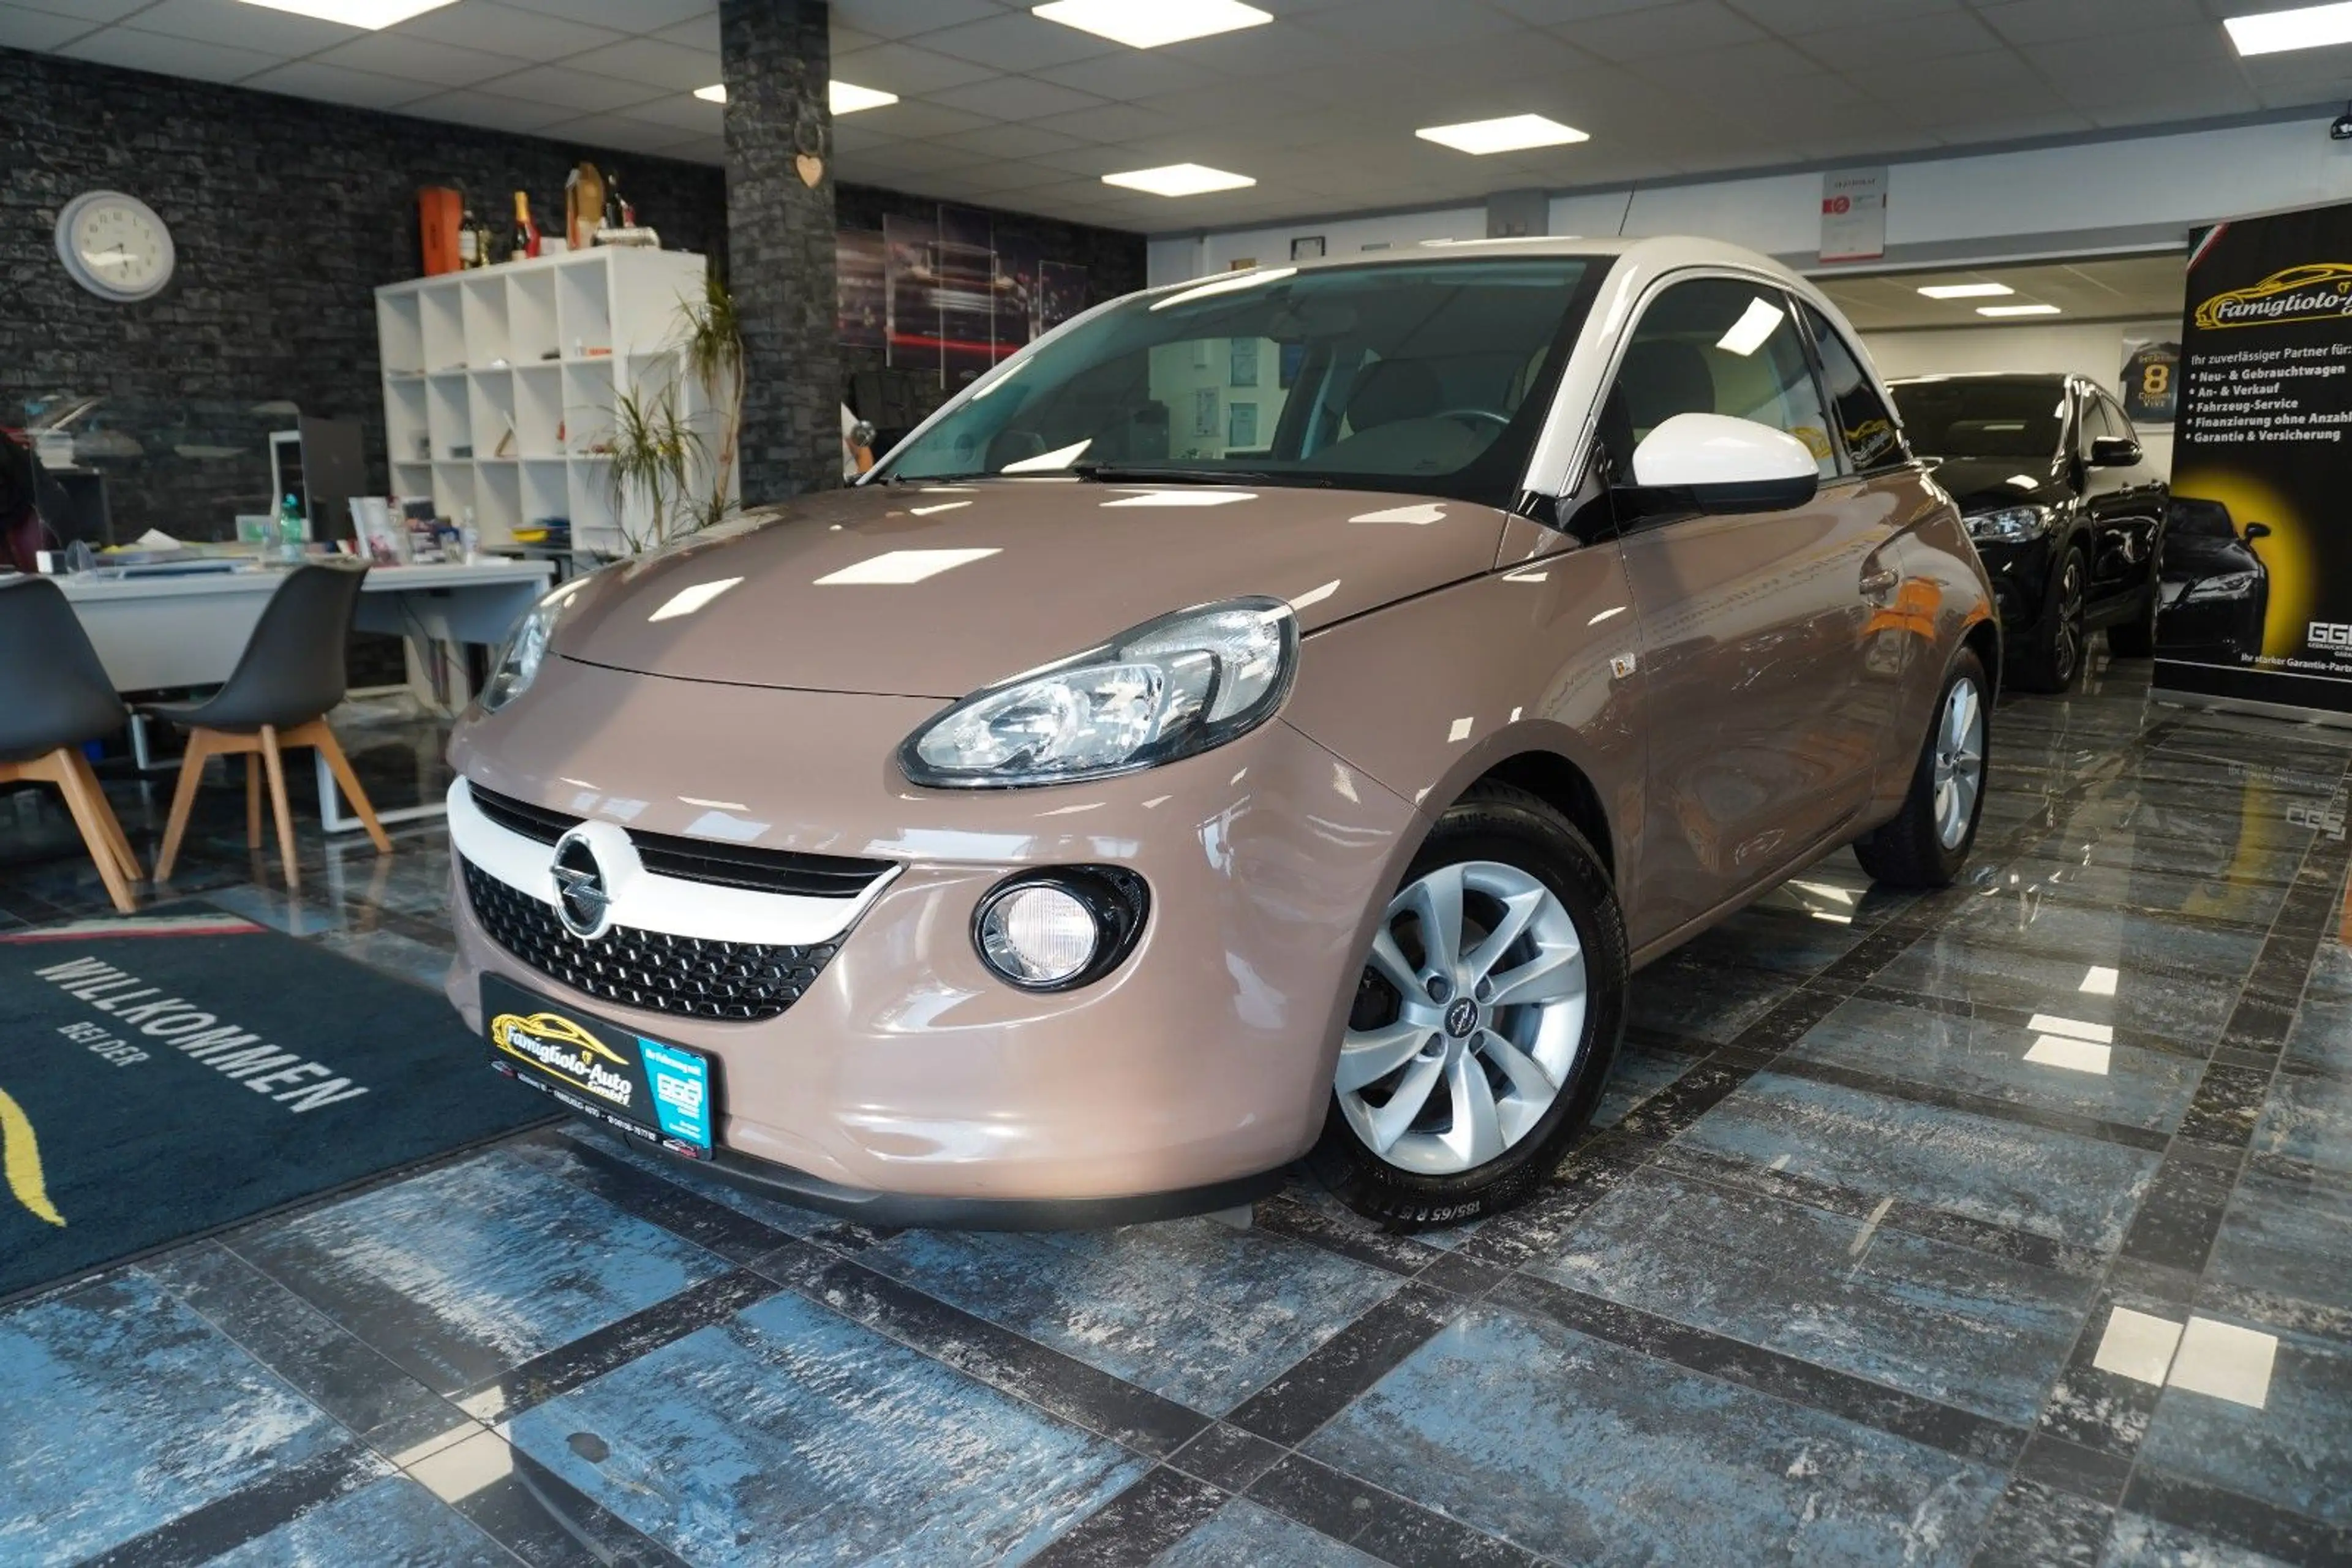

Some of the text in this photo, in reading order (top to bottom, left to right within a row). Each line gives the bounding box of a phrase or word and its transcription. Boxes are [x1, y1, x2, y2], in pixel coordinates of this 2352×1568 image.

[2192, 355, 2206, 366] Ihr
[2208, 350, 2281, 364] zuverlässiger
[2284, 347, 2329, 358] Partner
[2143, 364, 2169, 394] 8
[2199, 364, 2345, 382] Neu- & Gebrauchtwagen
[2198, 382, 2280, 398] An- & Verkauf
[2196, 398, 2298, 413] Fahrzeug-Service
[2195, 416, 2272, 428] Finanzierung
[2274, 413, 2305, 424] ohne
[2194, 429, 2341, 443] Garantie & Versicherung
[34, 957, 369, 1114] WILLKOMMEN
[56, 1021, 150, 1067] BEI DER
[507, 1025, 633, 1095] Famigliolo-Auto
